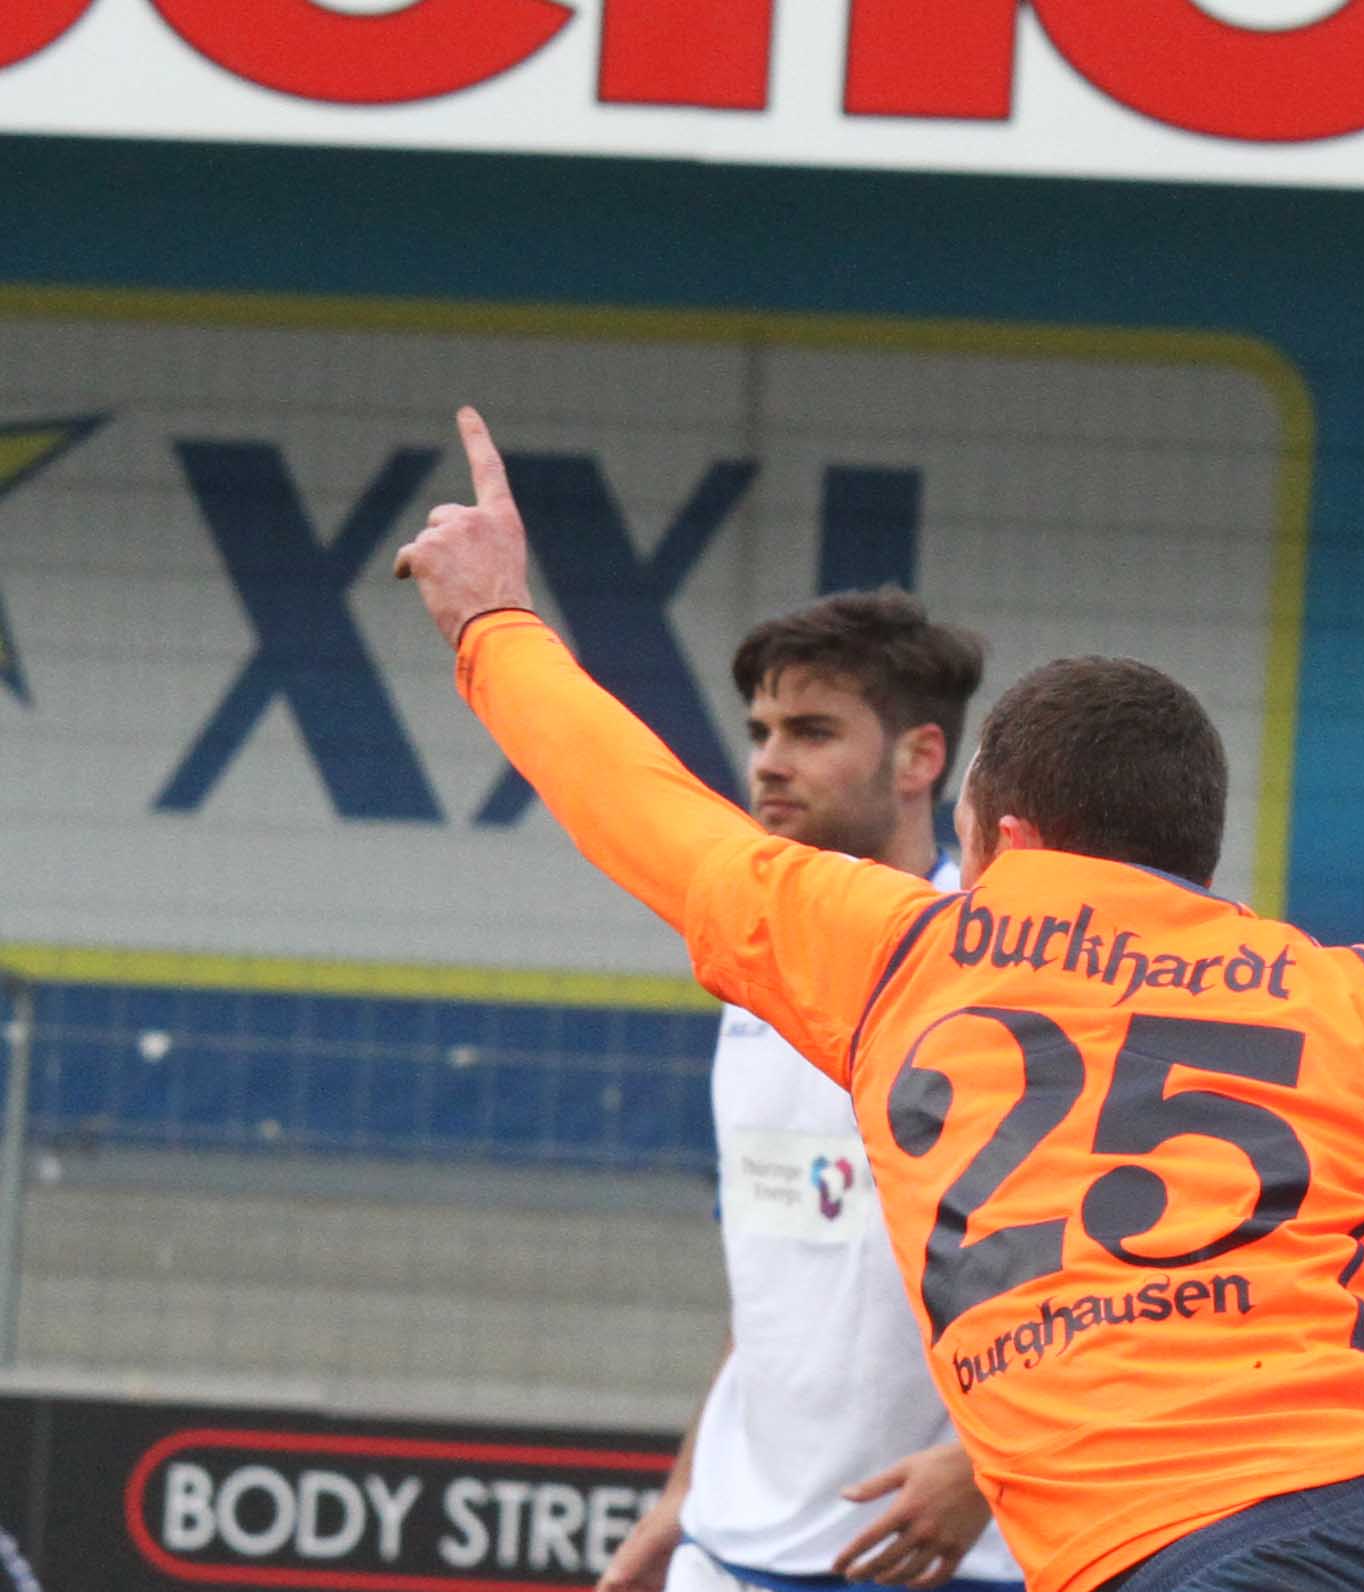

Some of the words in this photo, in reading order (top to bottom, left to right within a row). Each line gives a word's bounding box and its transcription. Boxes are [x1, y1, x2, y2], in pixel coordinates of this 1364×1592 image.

[950, 887, 1298, 1007] burkhardt
[886, 1006, 1312, 1347] 25
[953, 1271, 1254, 1394] burghausen
[162, 1460, 422, 1564] BODY
[438, 1476, 668, 1574] STRE
